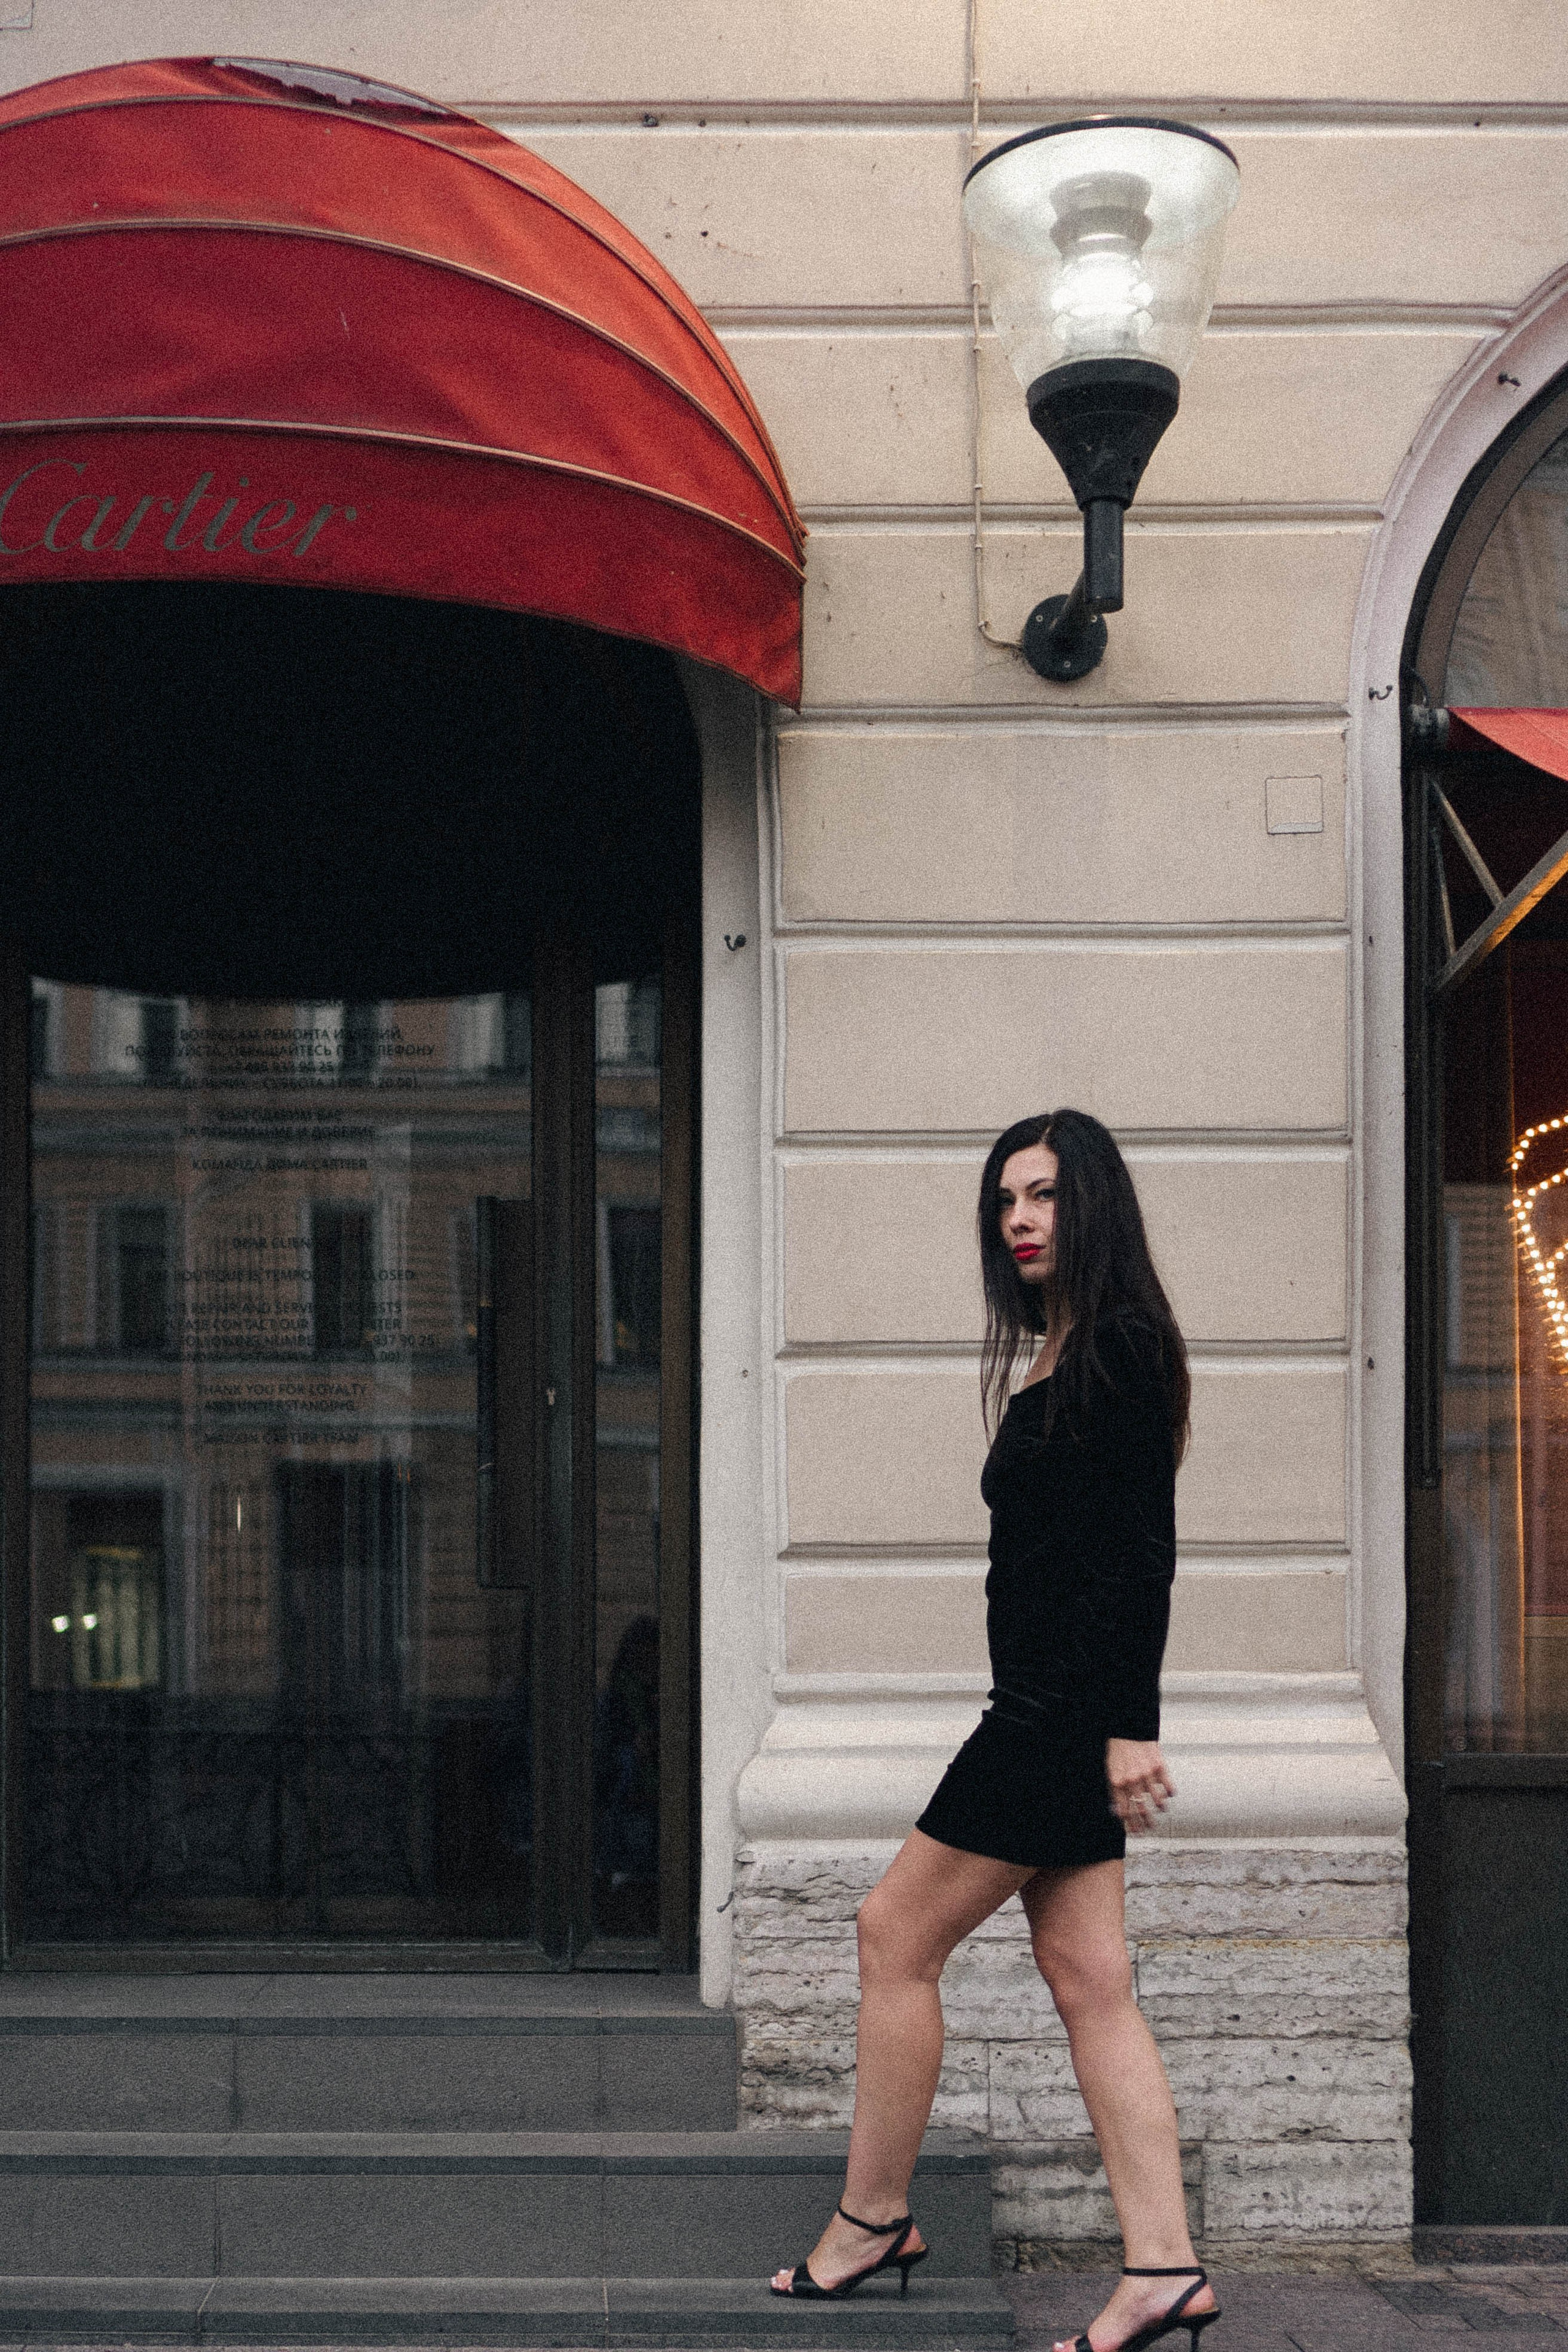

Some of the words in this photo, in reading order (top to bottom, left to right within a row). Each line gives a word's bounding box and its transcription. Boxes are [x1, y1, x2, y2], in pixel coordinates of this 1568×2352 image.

[0, 458, 357, 556] Cartier
[361, 1045, 435, 1057] ЕЛЕФОНУ
[246, 1383, 274, 1395] YOU
[279, 1383, 305, 1395] FOR
[309, 1382, 366, 1395] LOYALTY
